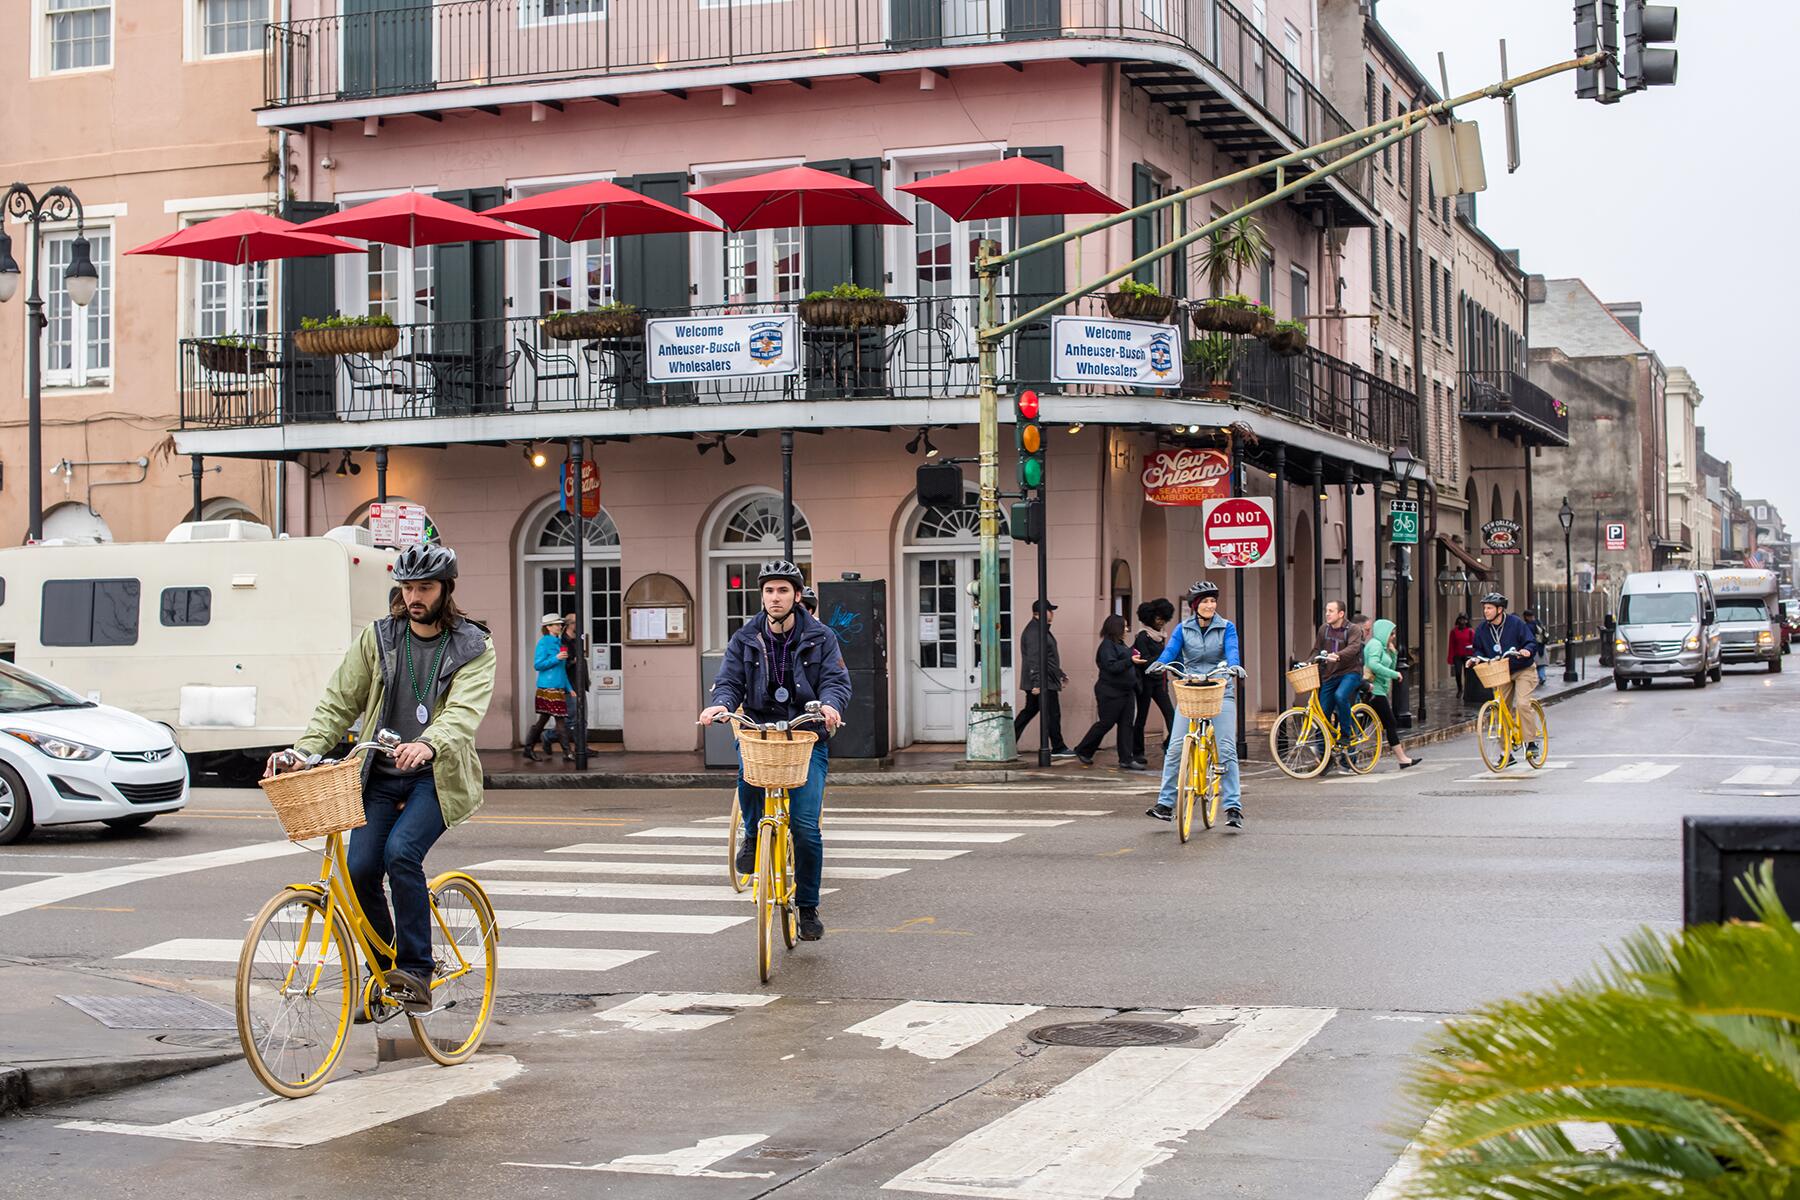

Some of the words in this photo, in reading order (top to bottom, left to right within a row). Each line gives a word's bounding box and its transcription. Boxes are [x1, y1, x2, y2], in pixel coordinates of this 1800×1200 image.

[675, 325, 724, 338] Welcome
[1085, 326, 1132, 340] Welcome
[658, 341, 741, 356] Anheuser-Busch
[1065, 344, 1146, 360] Anheuser-Busch
[669, 360, 731, 373] Wholesalers
[1076, 362, 1138, 377] Wholesalers
[1156, 449, 1212, 474] New
[1142, 463, 1230, 489] Orleans
[371, 507, 381, 515] NO
[1213, 513, 1231, 524] DO
[1236, 511, 1262, 523] NOT
[1483, 521, 1495, 532] NEW
[1495, 520, 1519, 532] ORLEANS
[1610, 526, 1621, 539] P
[1220, 541, 1259, 553] ENTER
